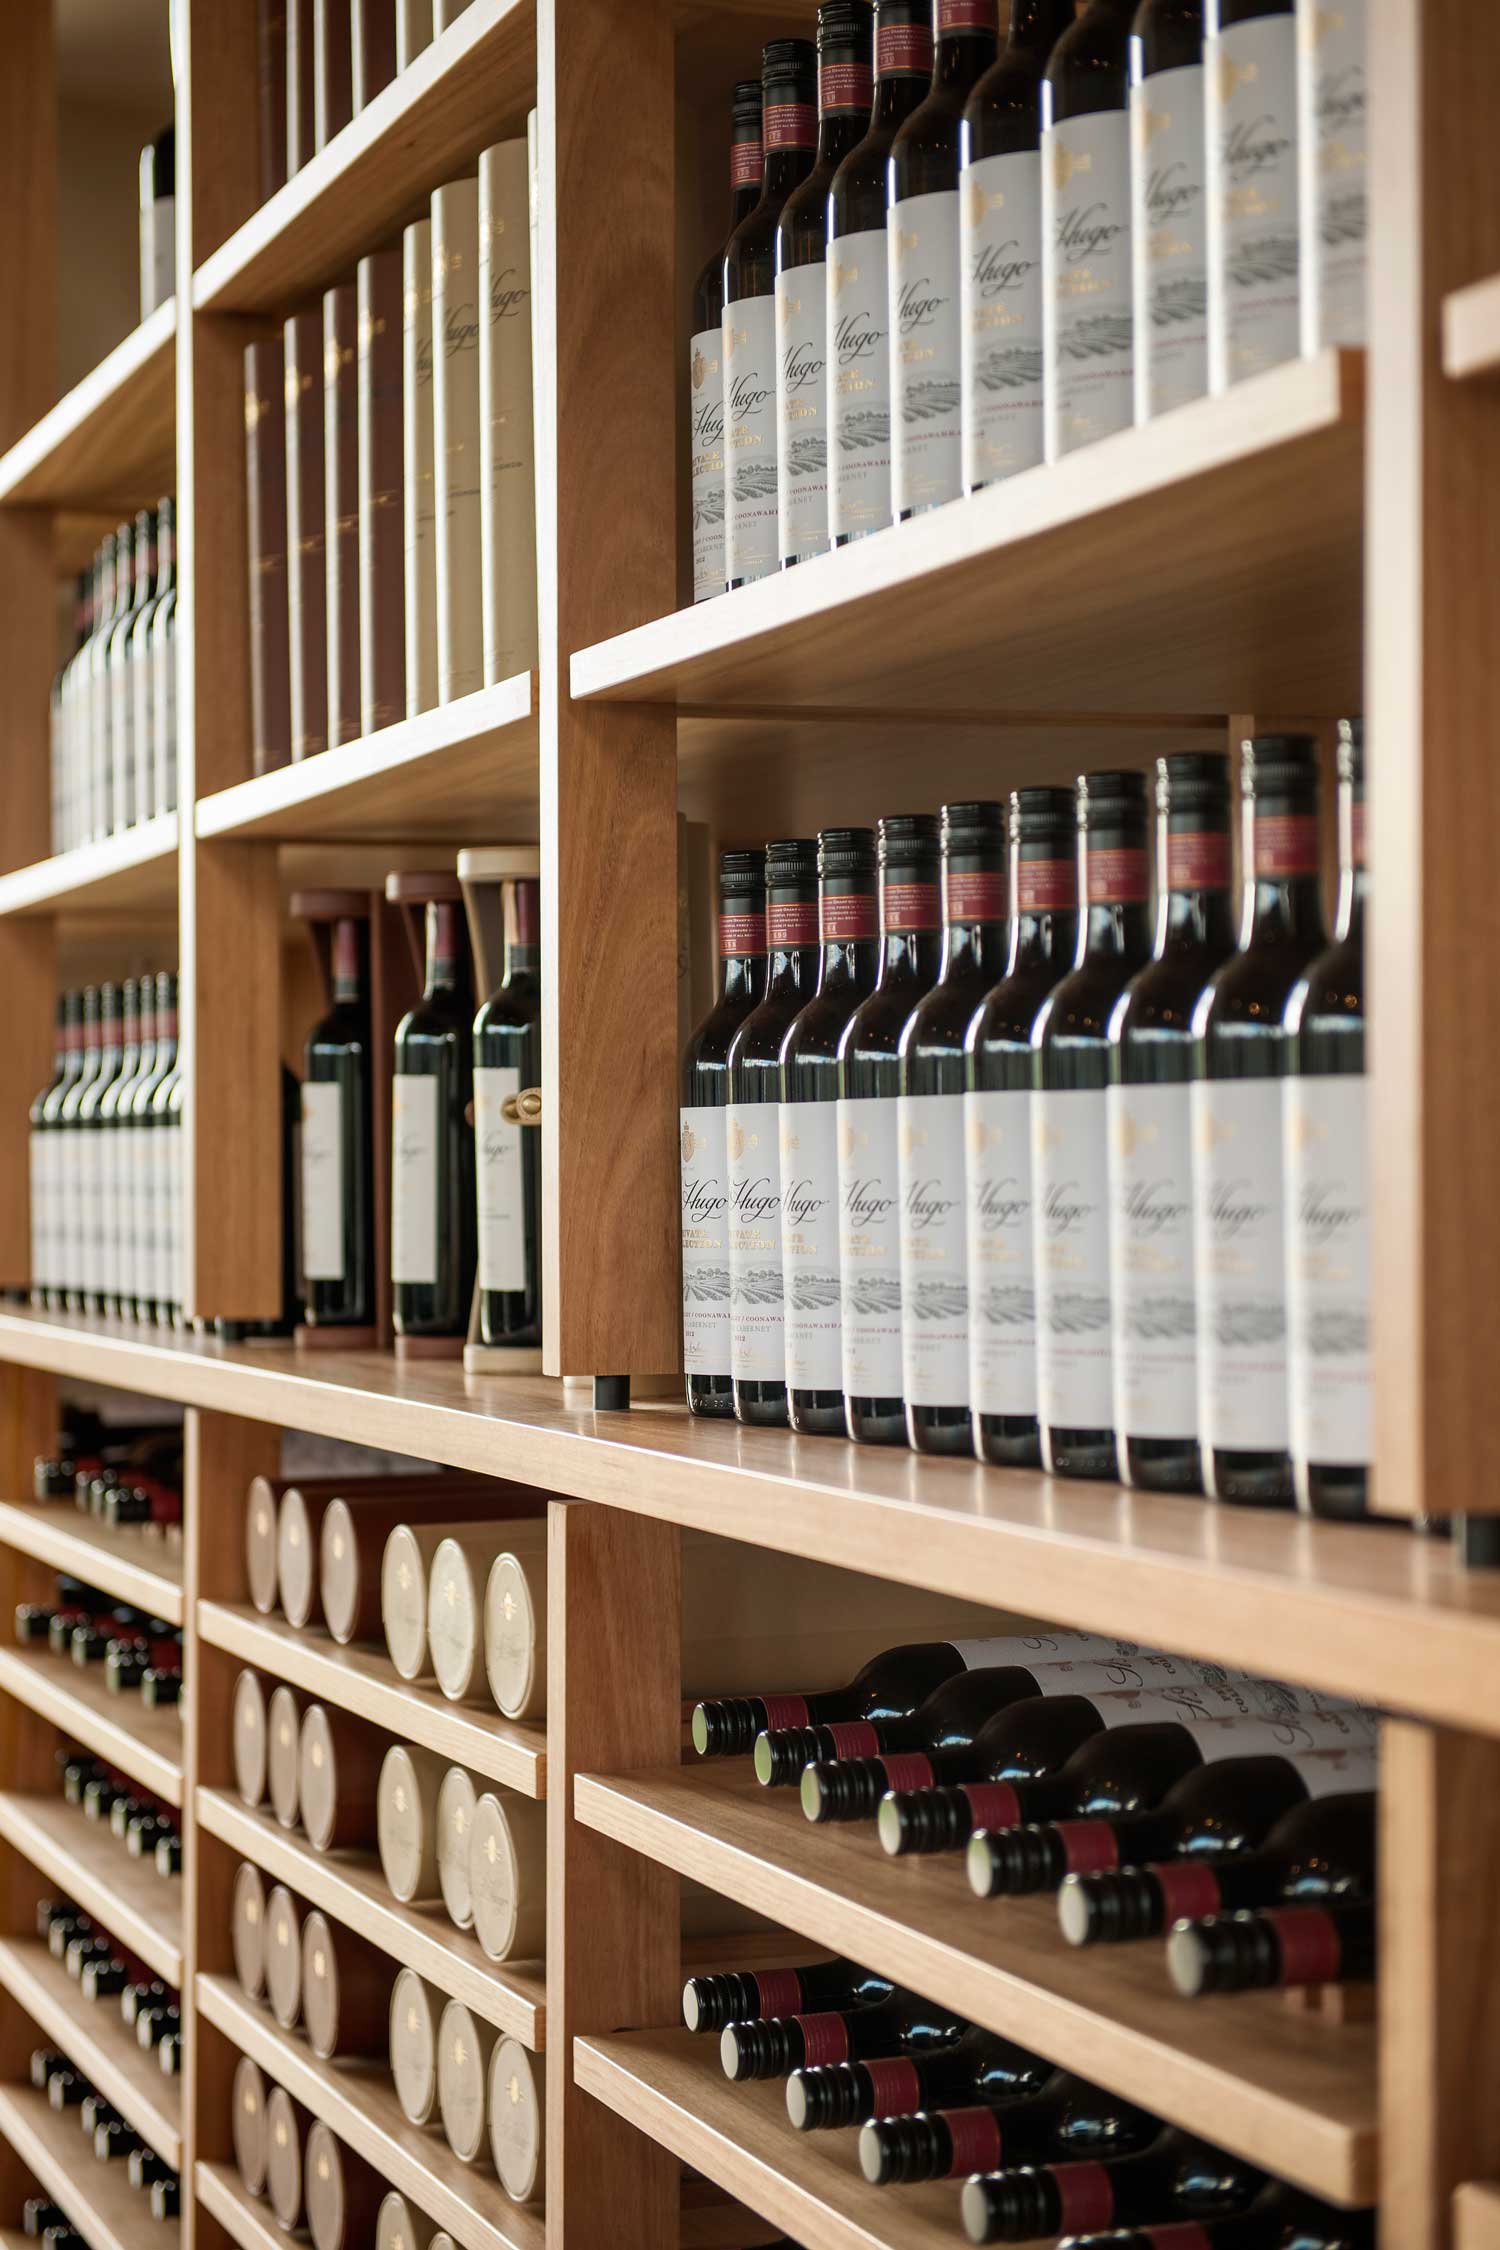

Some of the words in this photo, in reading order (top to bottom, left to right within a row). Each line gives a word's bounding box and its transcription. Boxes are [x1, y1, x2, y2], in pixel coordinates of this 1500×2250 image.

[1145, 161, 1206, 226] Hugo
[1056, 202, 1130, 262] Hugo
[972, 239, 1041, 297] Hugo
[897, 278, 950, 334] Hugo
[834, 311, 889, 365] Hugo
[783, 342, 826, 394] Hugo
[729, 372, 776, 422] Hugo
[693, 401, 726, 447] Hug
[683, 1178, 728, 1223] Hugo
[733, 1177, 780, 1223] Hugo
[783, 1179, 831, 1226] Hugo
[843, 1178, 898, 1228] Hugo
[905, 1178, 960, 1231] Hugo
[974, 1177, 1030, 1232] Hugo
[1043, 1179, 1098, 1237] Hugo
[745, 1315, 785, 1323] COONAWA
